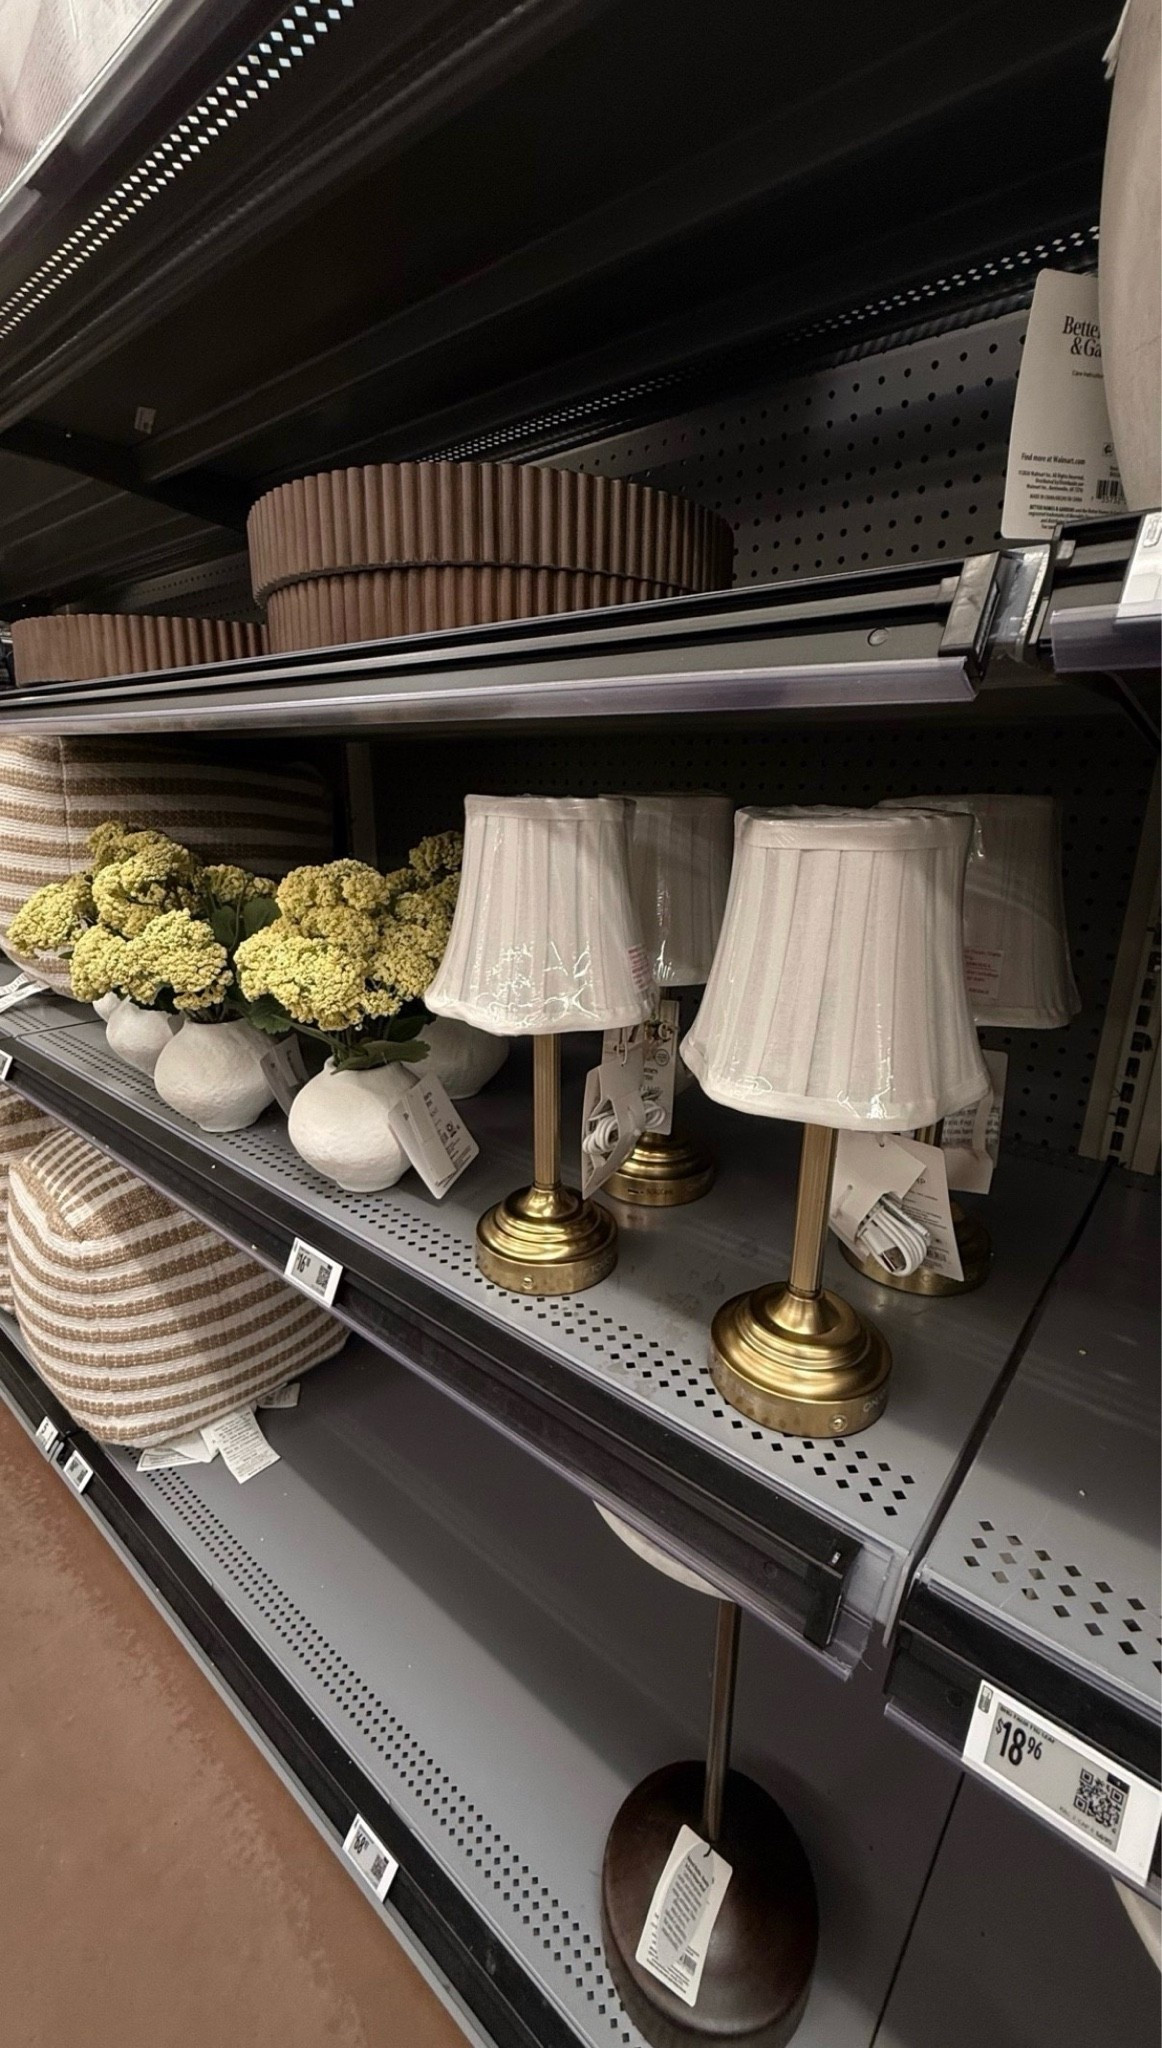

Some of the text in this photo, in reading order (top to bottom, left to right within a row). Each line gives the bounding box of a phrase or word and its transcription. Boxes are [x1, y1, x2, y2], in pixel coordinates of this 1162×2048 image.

[1070, 336, 1082, 355] &
[1021, 452, 1086, 465] Find more at Walmart.com
